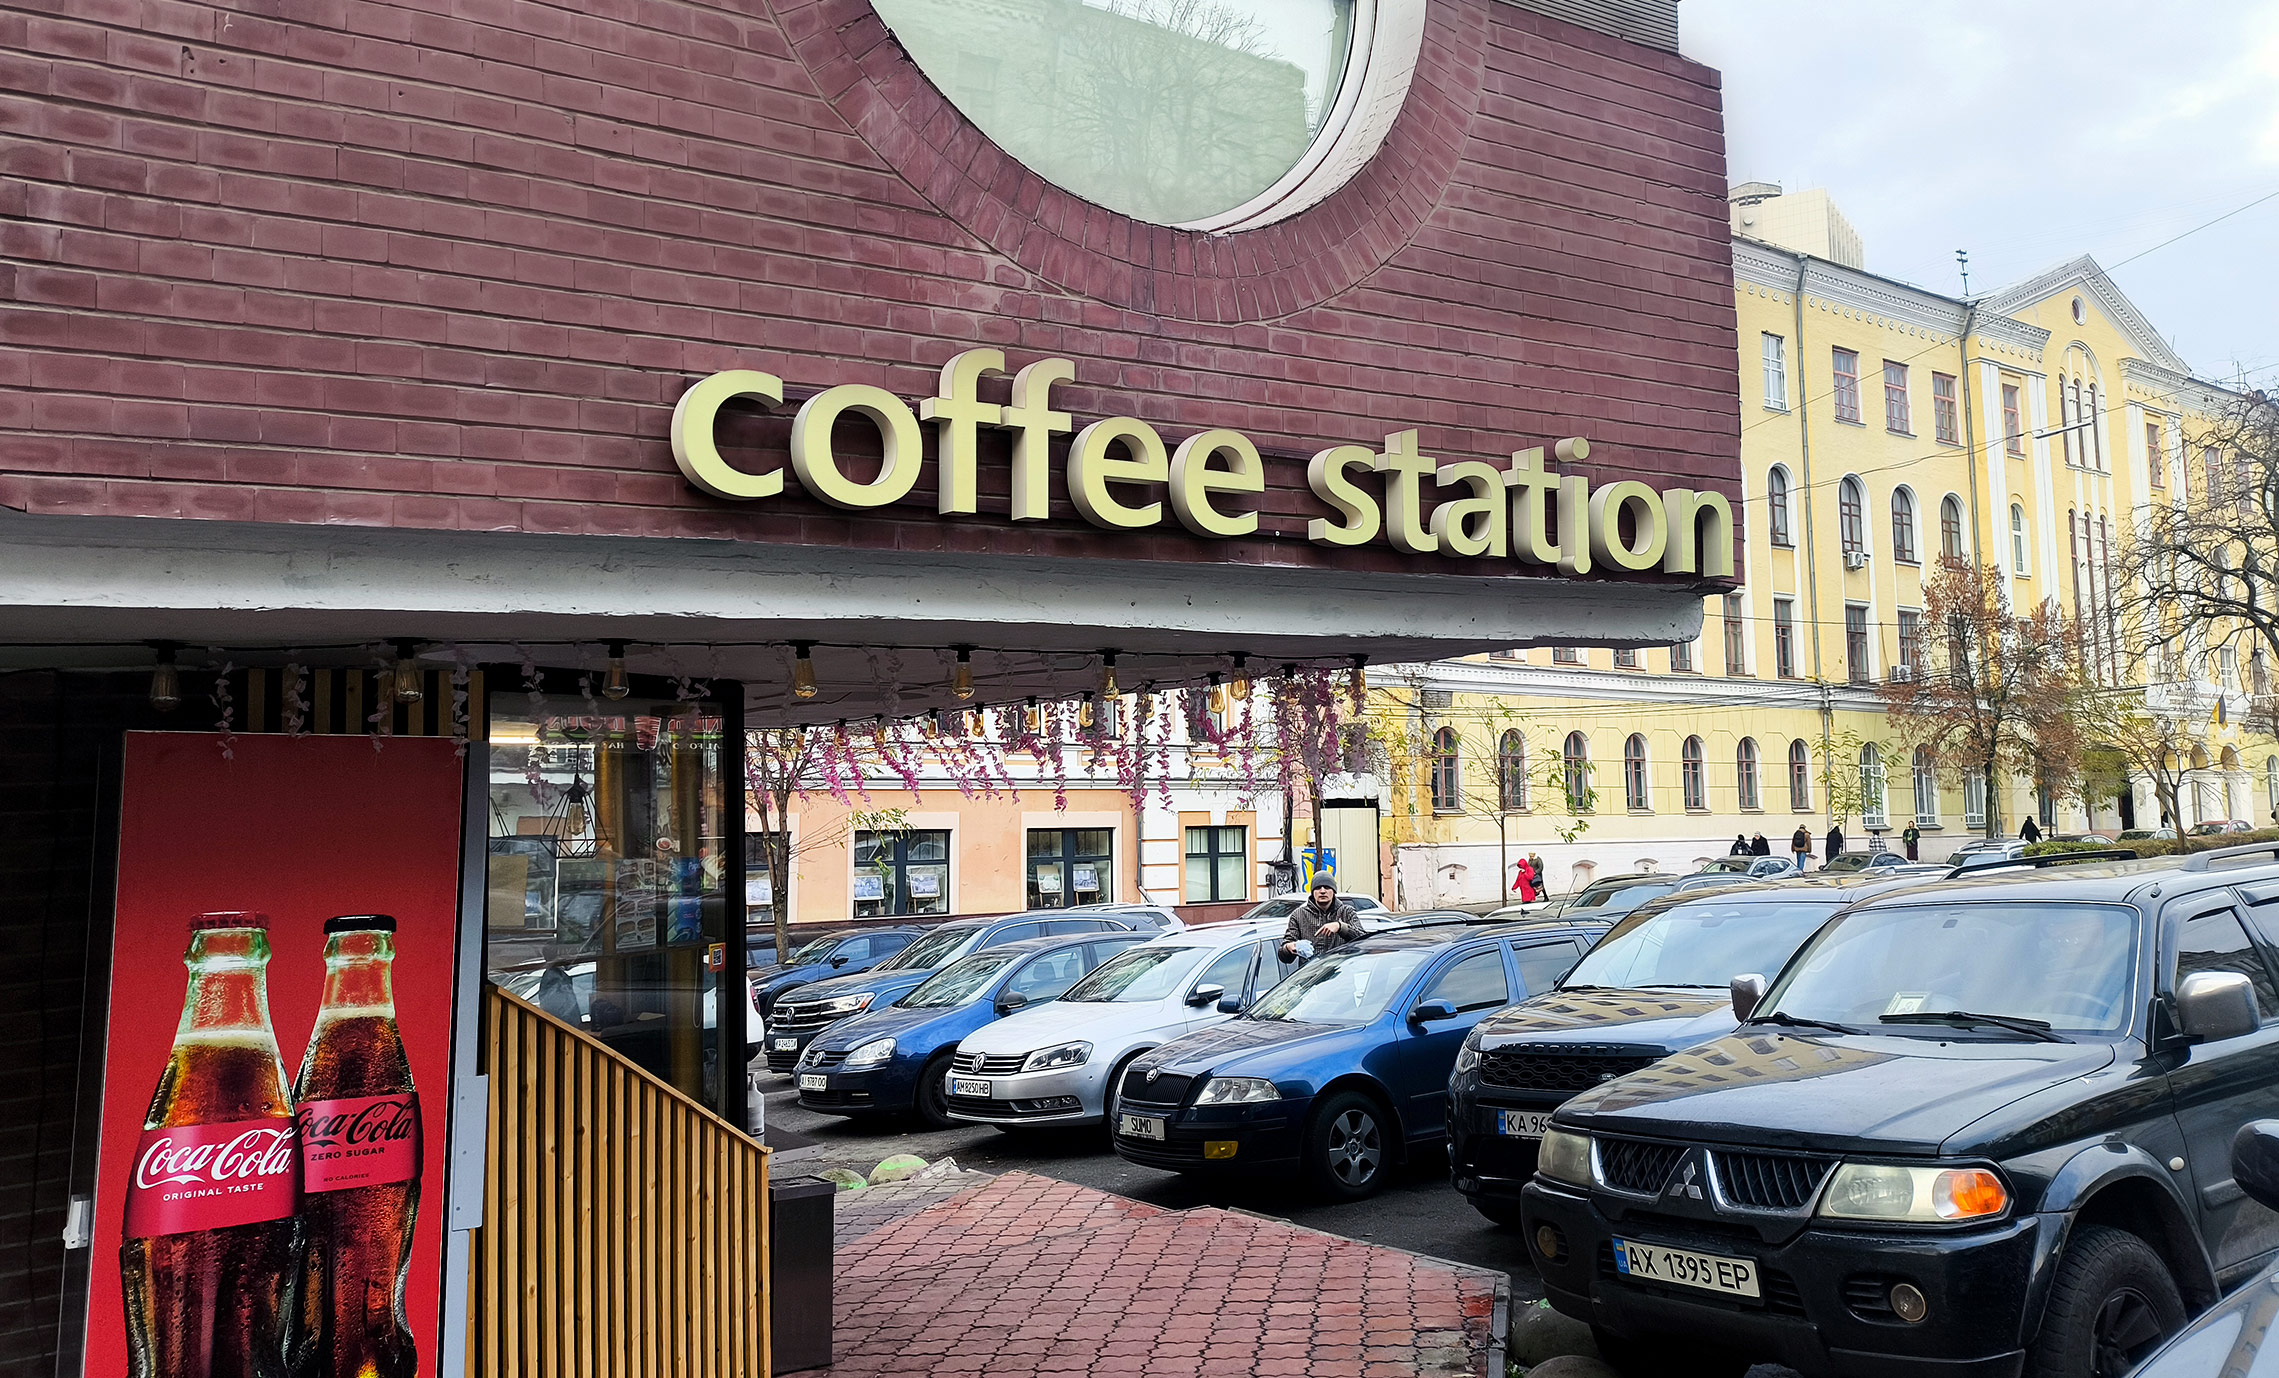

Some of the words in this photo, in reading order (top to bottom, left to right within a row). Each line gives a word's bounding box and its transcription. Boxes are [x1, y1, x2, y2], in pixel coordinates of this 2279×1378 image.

[671, 347, 1265, 539] coffee
[1308, 428, 1734, 577] station
[1131, 1117, 1152, 1134] SUMO
[1506, 1114, 1528, 1133] KA
[136, 1127, 298, 1189] Coca-Cola
[310, 1151, 342, 1162] ZERO
[346, 1147, 385, 1158] SUGAR
[162, 1187, 222, 1201] ORIGINAL
[227, 1182, 264, 1194] TASTE
[1629, 1246, 1659, 1275] AX
[1663, 1252, 1712, 1284] 1395
[1715, 1260, 1750, 1290] EP
